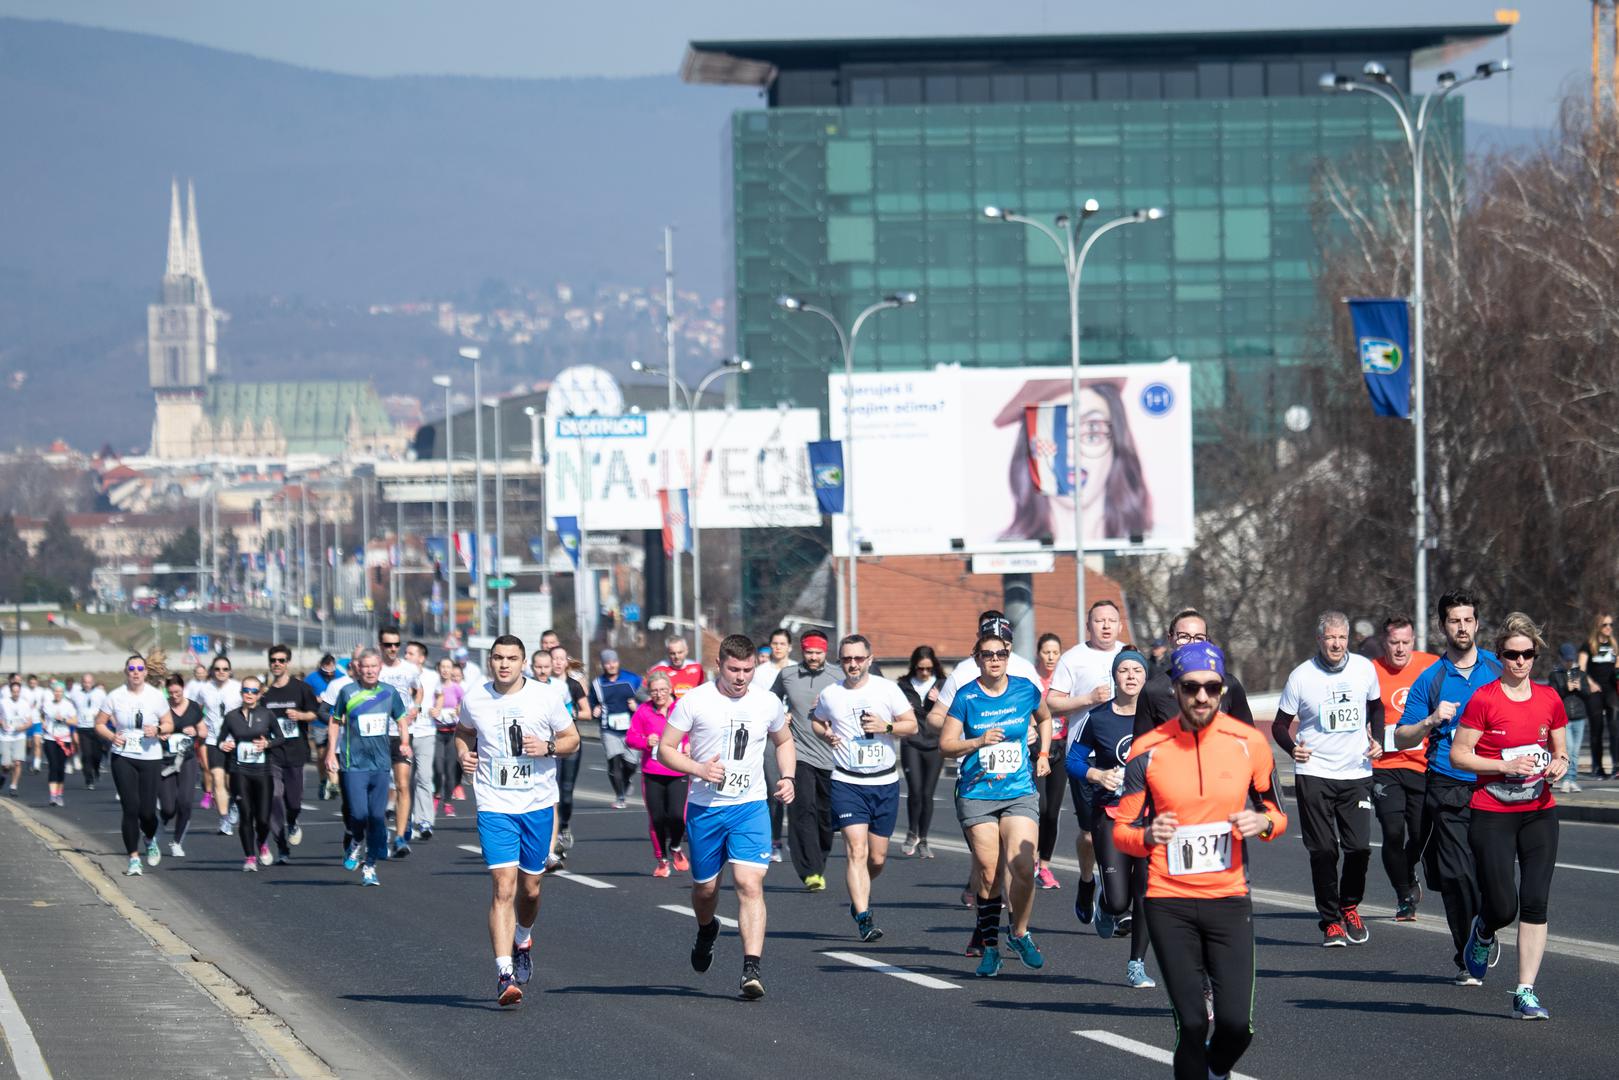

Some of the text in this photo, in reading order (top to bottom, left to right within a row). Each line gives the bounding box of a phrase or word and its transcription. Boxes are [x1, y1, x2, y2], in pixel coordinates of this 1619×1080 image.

[1146, 391, 1169, 408] 1+1
[1338, 707, 1360, 722] 623
[867, 744, 884, 758] 551
[998, 749, 1021, 763] 332
[1527, 752, 1550, 767] 29
[512, 764, 531, 779] 241
[728, 772, 750, 789] 245
[1197, 831, 1232, 856] 377
